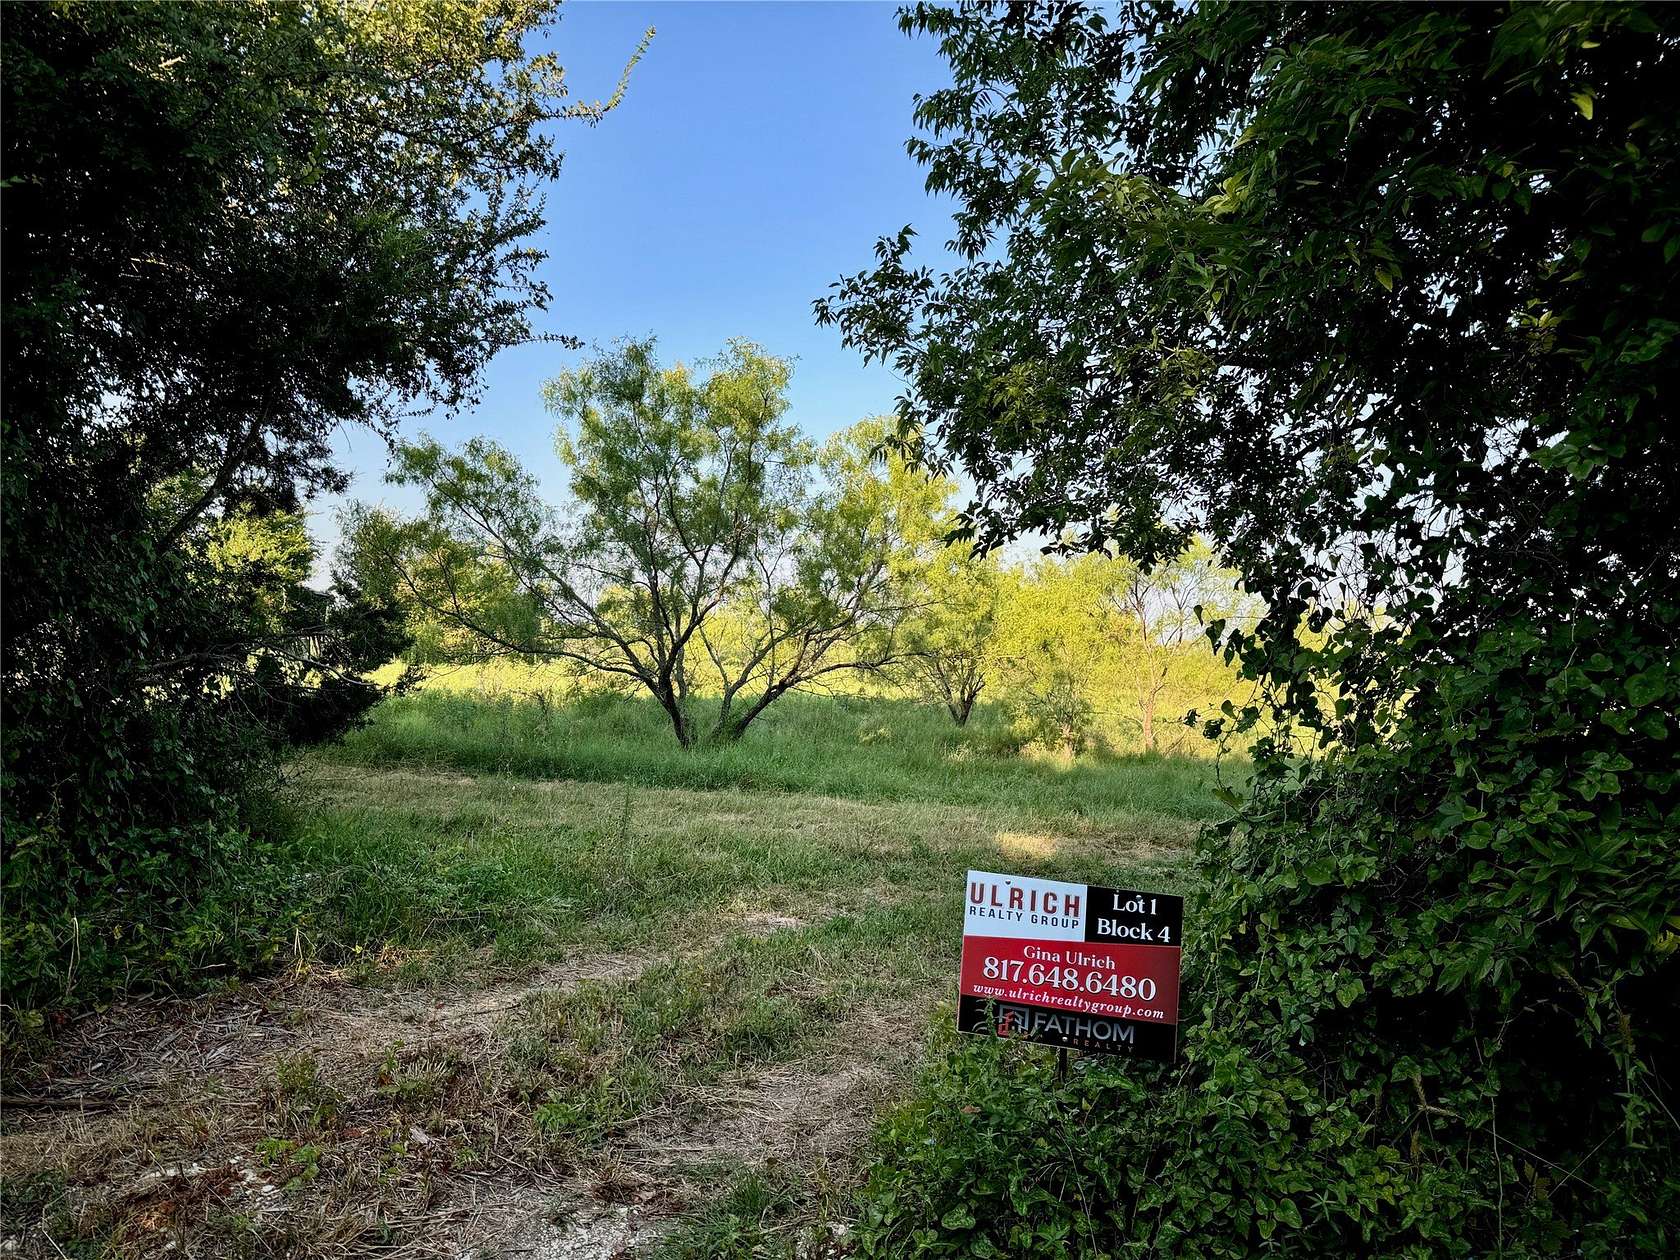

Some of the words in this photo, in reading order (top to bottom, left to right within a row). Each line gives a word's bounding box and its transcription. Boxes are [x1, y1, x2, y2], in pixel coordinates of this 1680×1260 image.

[970, 882, 1080, 918] ULRICH
[1112, 891, 1146, 915] Lot
[1150, 898, 1157, 916] 1
[969, 905, 1024, 922] REALTY
[1030, 914, 1080, 930] GROUP
[1097, 917, 1153, 941] Block
[1157, 925, 1171, 943] 4
[1023, 945, 1061, 962] Gina
[1065, 951, 1116, 970] Ulrich
[982, 956, 1157, 1001] 817.648.6480
[973, 983, 1165, 1019] www.ulrichrealtygroup.com
[1034, 1011, 1135, 1044] FATHOM
